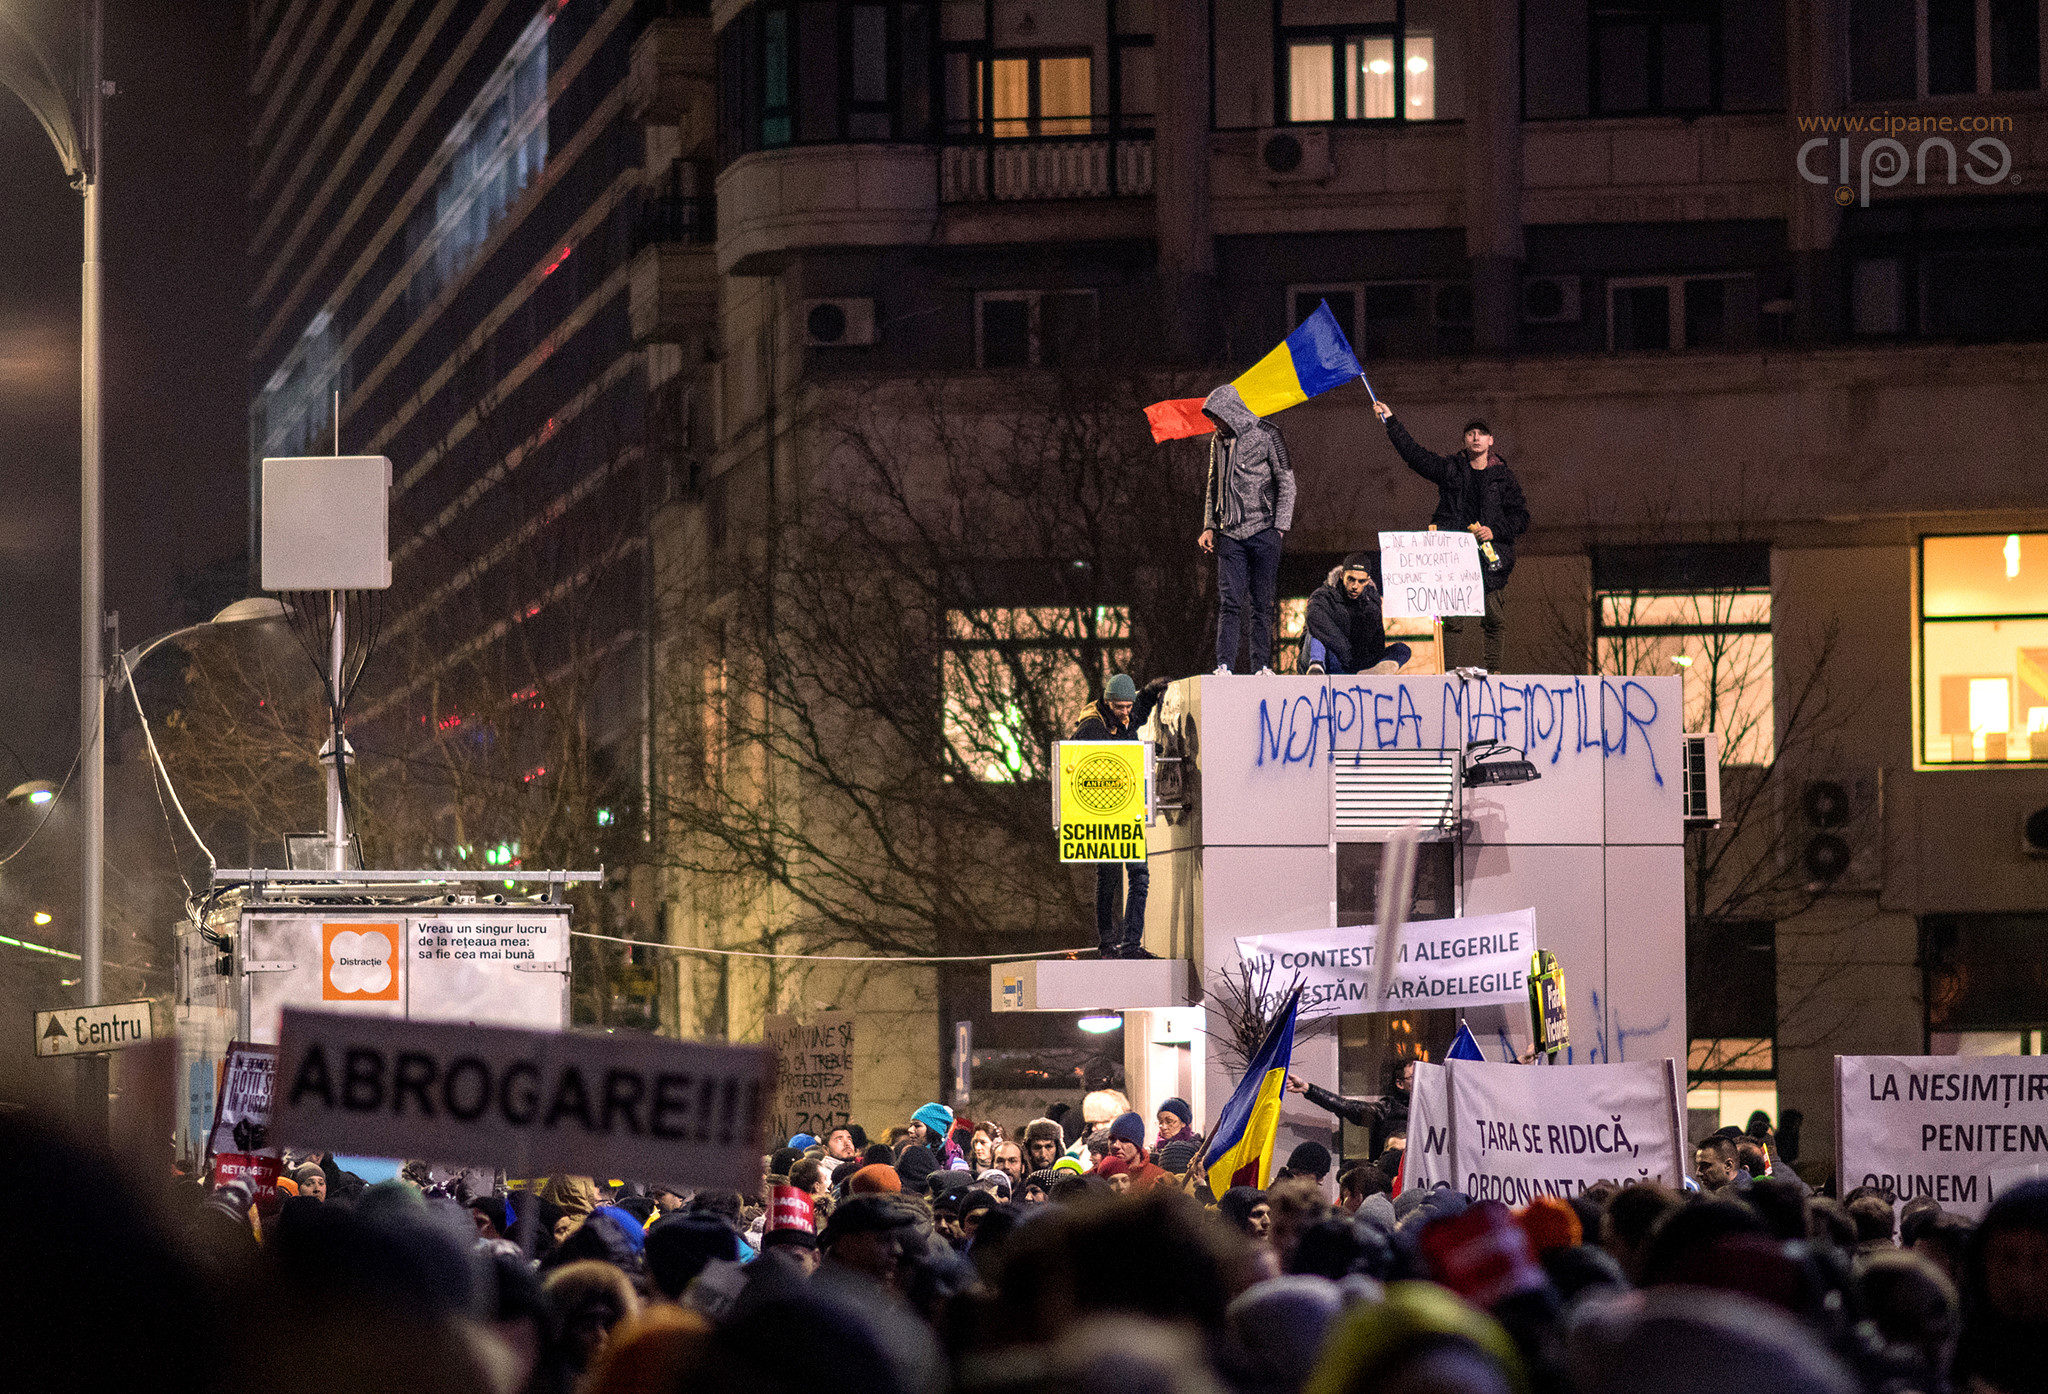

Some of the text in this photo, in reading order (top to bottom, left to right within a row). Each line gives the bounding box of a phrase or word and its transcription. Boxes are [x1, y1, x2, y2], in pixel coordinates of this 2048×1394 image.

[1256, 683, 1422, 767] NOAPTEA
[1063, 818, 1144, 840] SCHIMBĂ
[1063, 843, 1141, 859] CANALUL
[418, 923, 547, 937] Vreau un singur lucru
[418, 936, 432, 947] de
[436, 936, 448, 947] la
[500, 938, 530, 947] mea:
[436, 949, 451, 960] fie
[454, 950, 476, 960] cea
[479, 949, 501, 960] mai
[505, 949, 535, 960] bună
[1247, 932, 1519, 975] NU CONTESTM ALEGERILE
[75, 1013, 142, 1046] Centru
[290, 1039, 764, 1148] ABROGARE!!!
[1869, 1073, 1900, 1101] LA
[796, 1111, 850, 1136] 2017
[1476, 1114, 1639, 1159] ȚARA SE RIDICĂ,
